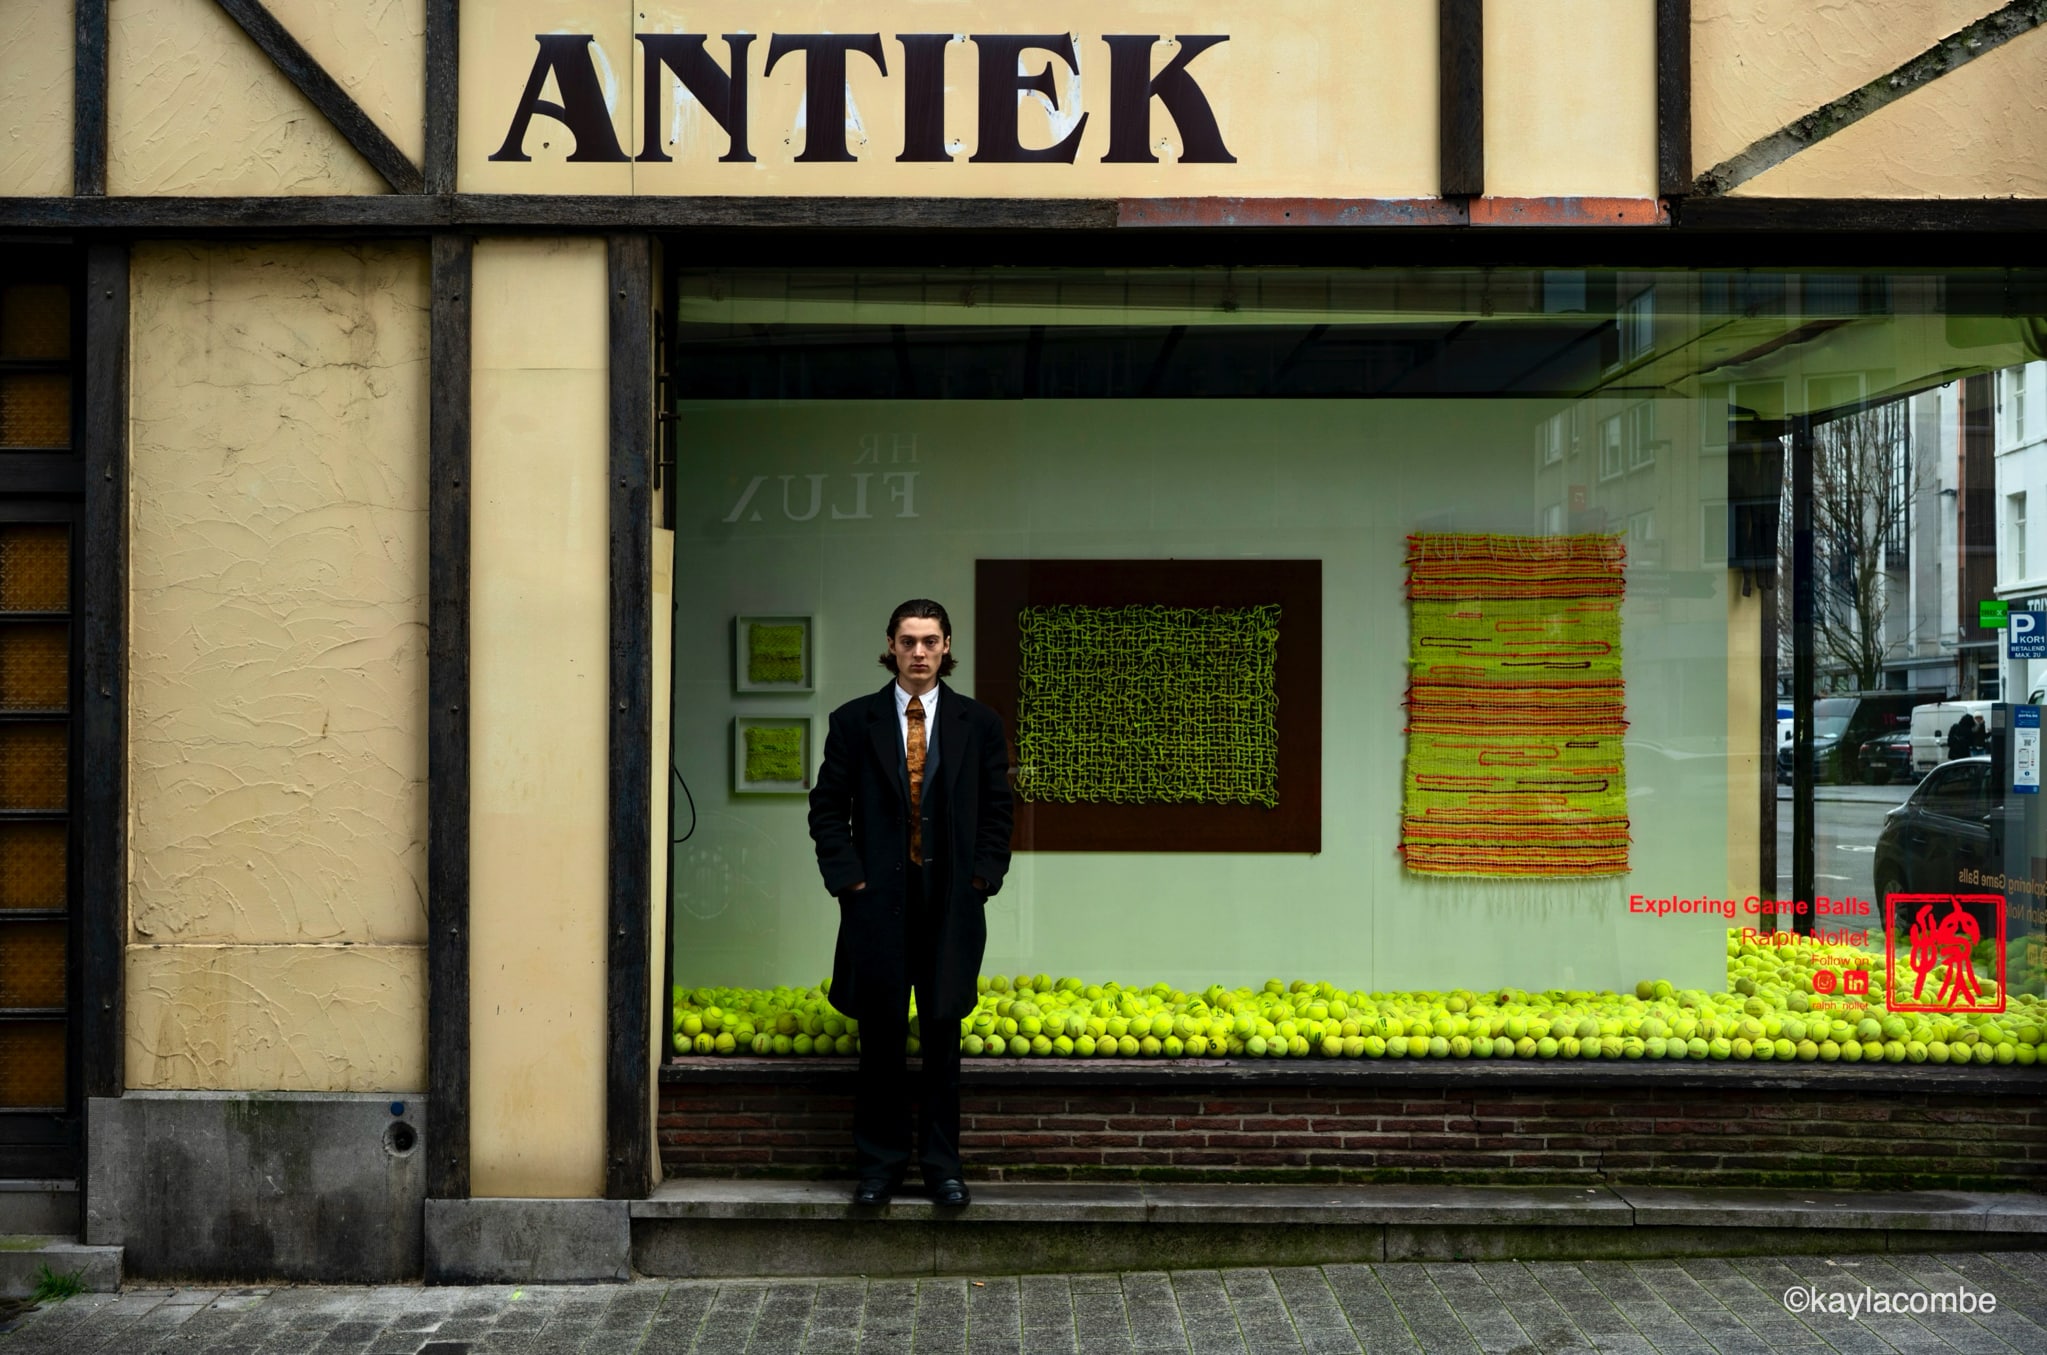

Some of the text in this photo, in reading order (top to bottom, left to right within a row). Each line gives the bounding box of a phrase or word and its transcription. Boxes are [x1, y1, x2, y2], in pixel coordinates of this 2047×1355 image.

[487, 31, 1238, 166] ANTIEK
[2011, 614, 2036, 644] P
[1629, 895, 1871, 918] Exploring Game Balls
[1742, 928, 1870, 950] Ralph Nollet
[1811, 954, 1870, 967] Follow on
[1812, 1001, 1869, 1013] ralph_nollet
